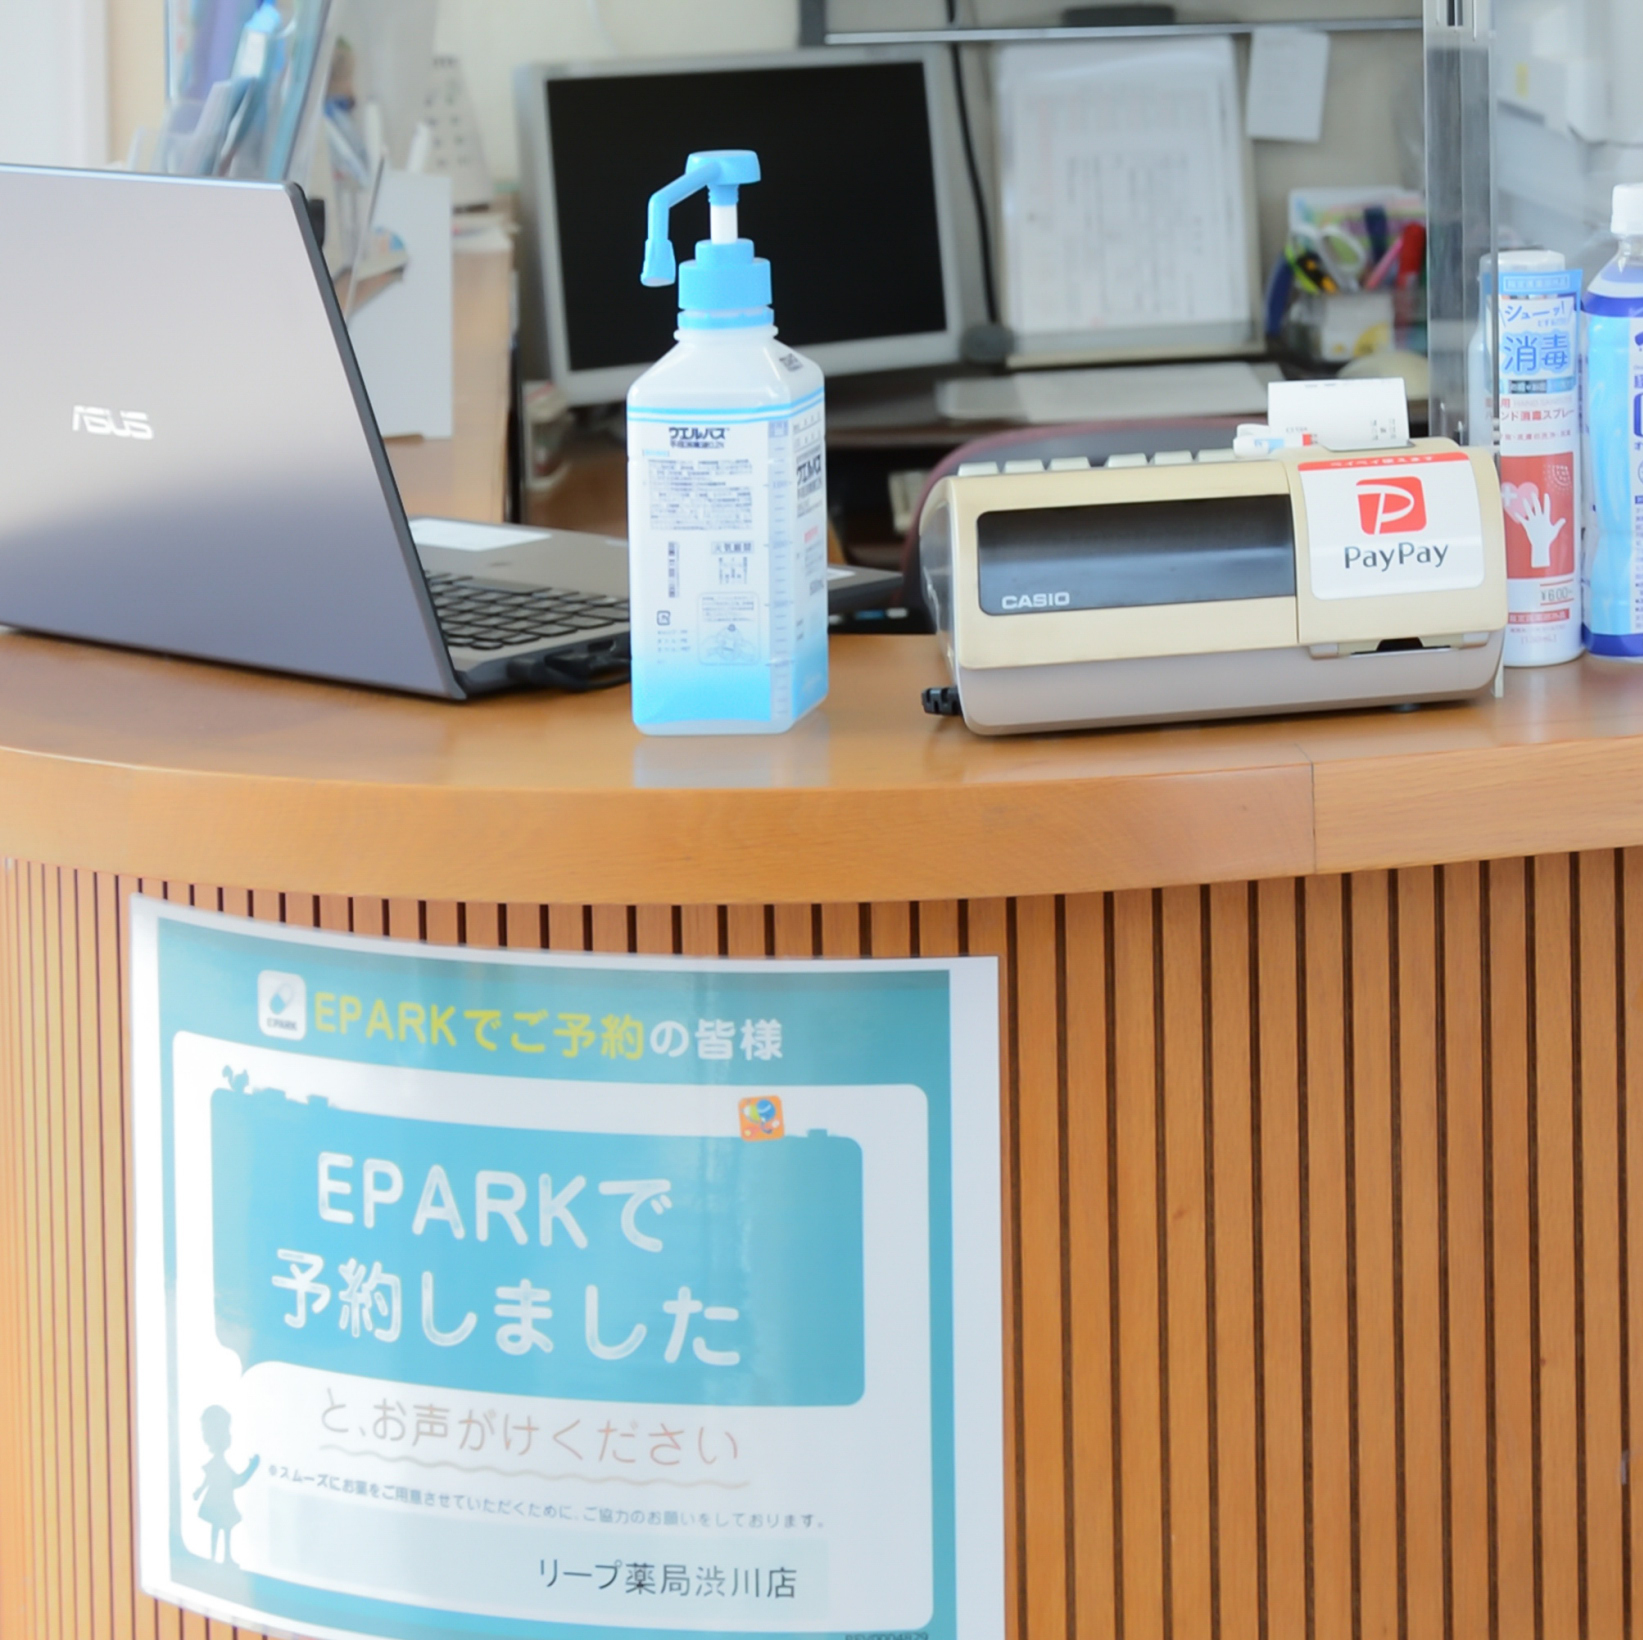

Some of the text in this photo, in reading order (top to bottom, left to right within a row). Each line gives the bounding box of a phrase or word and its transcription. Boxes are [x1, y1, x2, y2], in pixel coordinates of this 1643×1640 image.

[1503, 333, 1568, 372] 消毒
[72, 404, 154, 440] ASUS
[1344, 542, 1449, 572] PayPay
[1001, 591, 1070, 609] CASIO
[313, 991, 784, 1061] EPARKでご予約の皆様
[316, 1150, 674, 1253] EPARKで
[271, 1248, 742, 1367] 予約しました
[319, 1386, 741, 1467] と、お声がけください
[538, 1558, 798, 1599] リープ薬局渋川店
